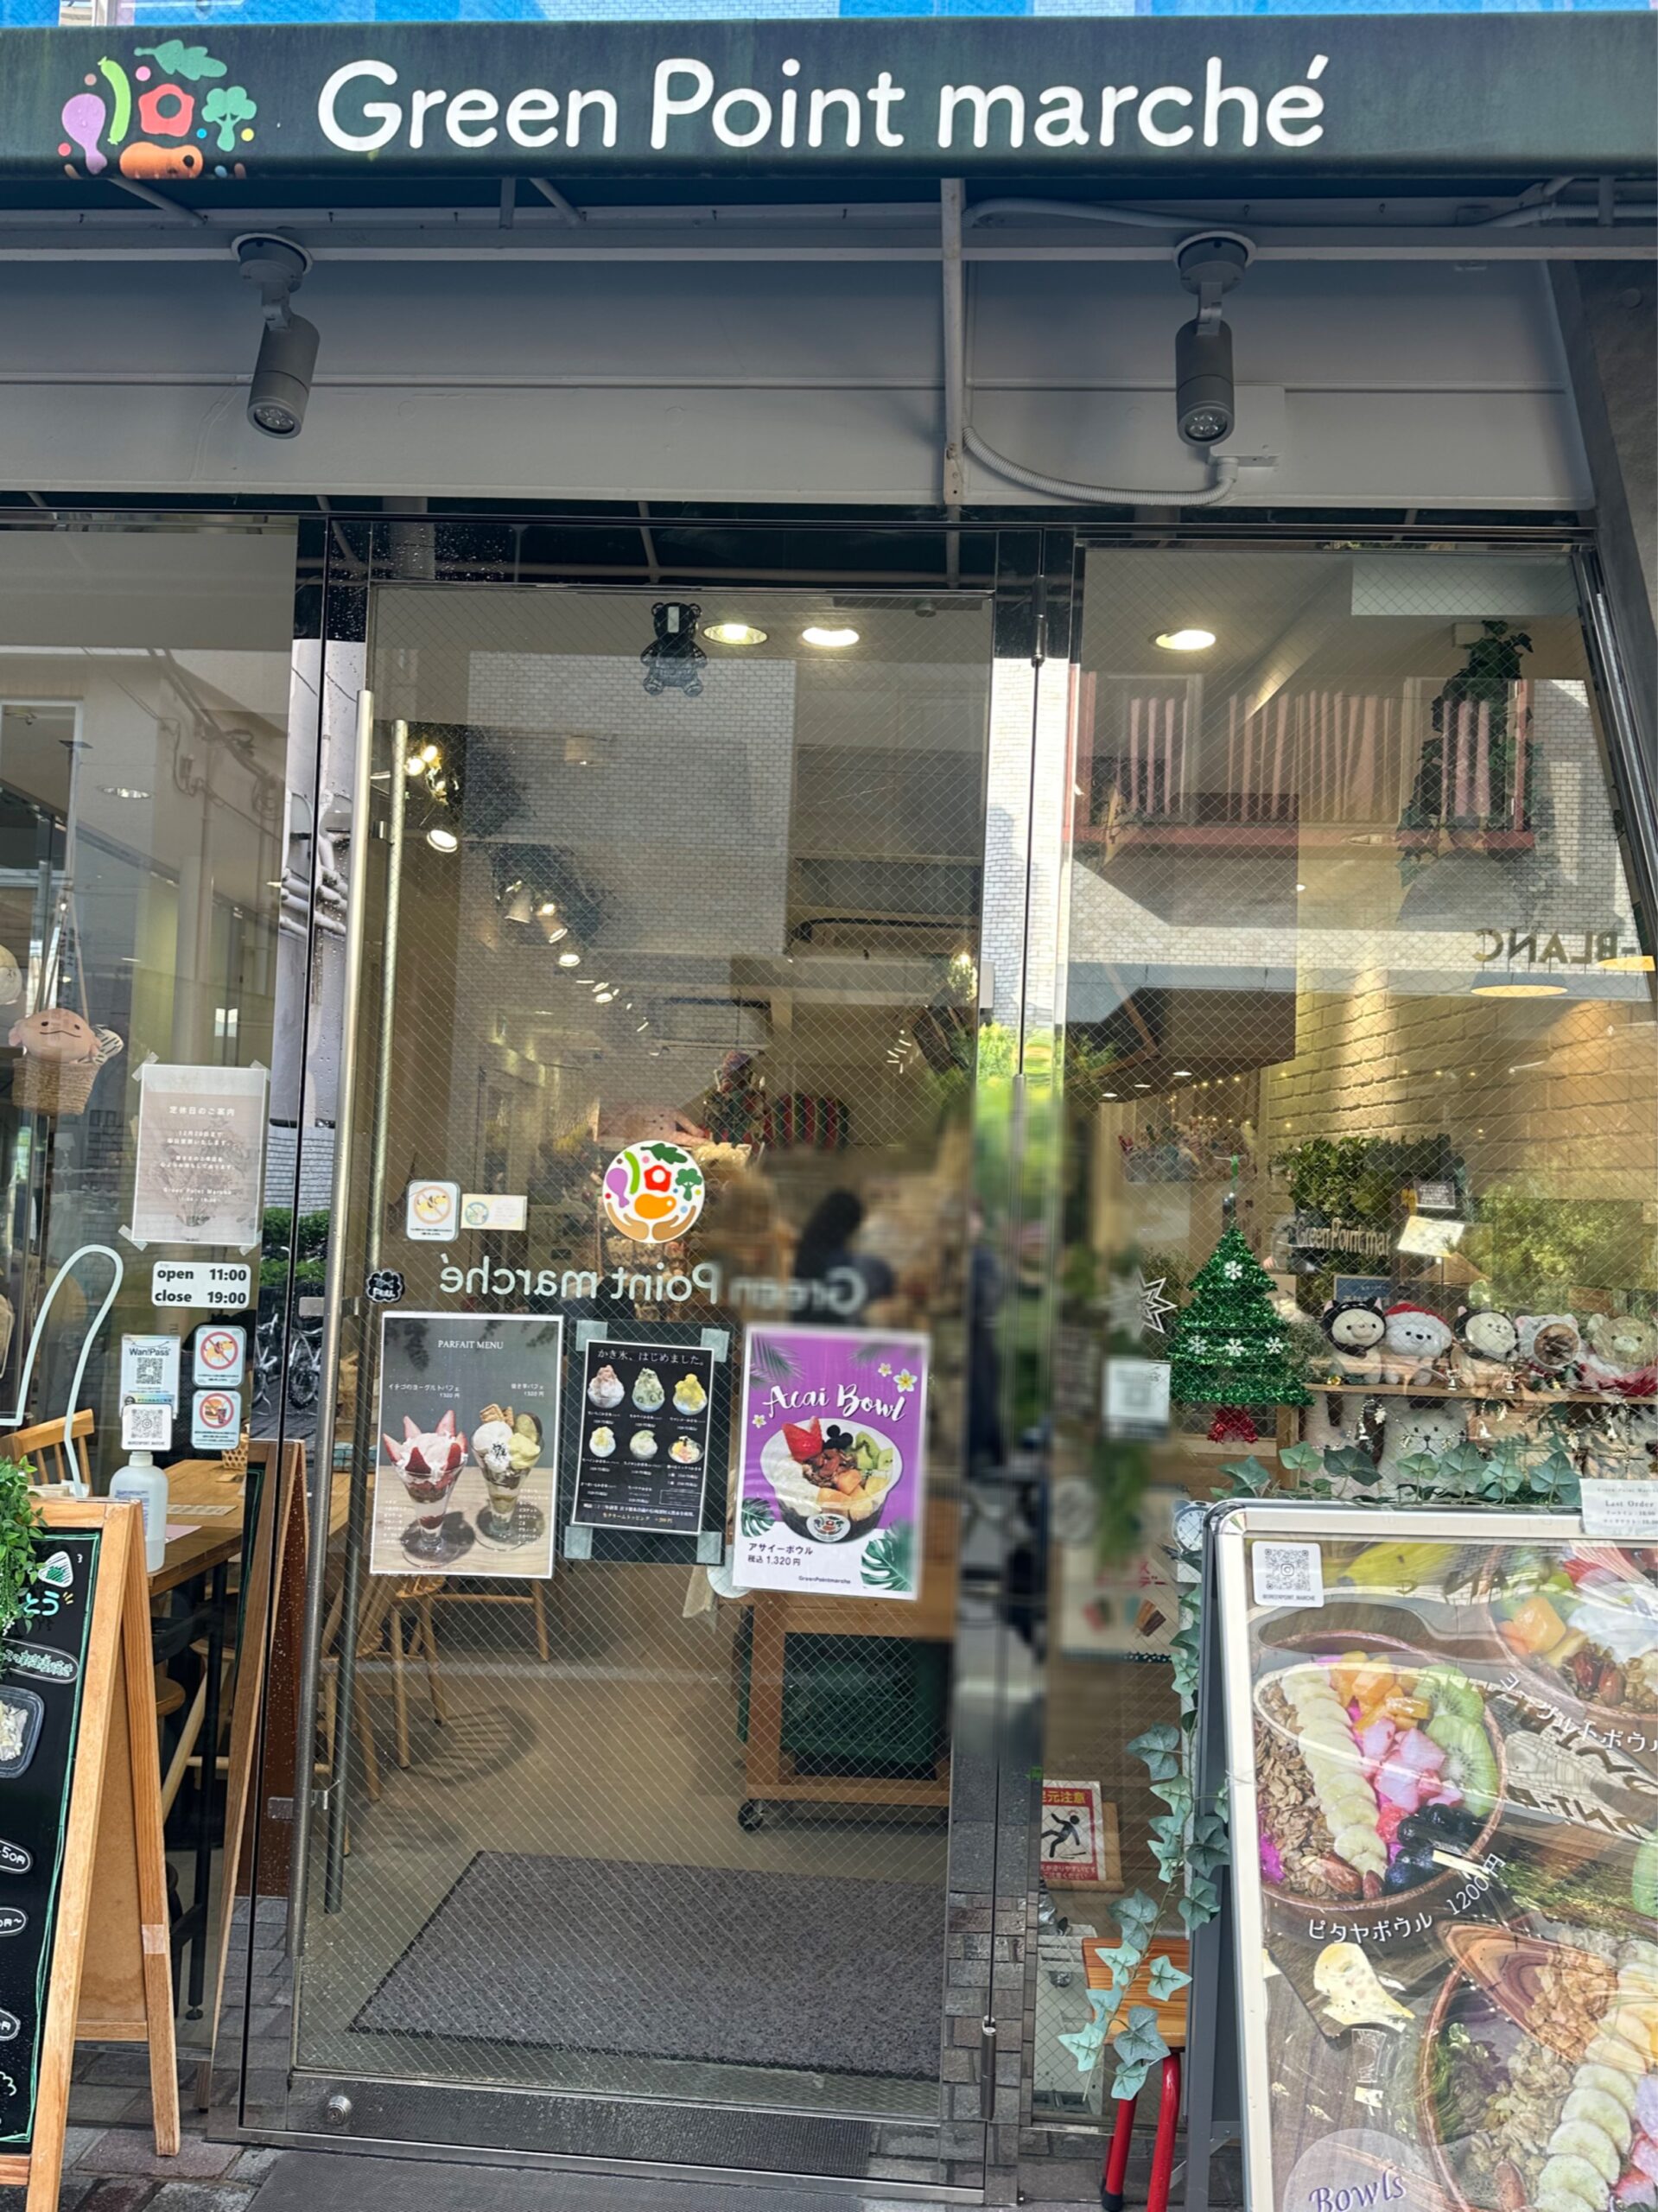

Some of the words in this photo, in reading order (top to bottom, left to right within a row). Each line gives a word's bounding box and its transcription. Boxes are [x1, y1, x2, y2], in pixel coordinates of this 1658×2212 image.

[319, 60, 617, 151] Green
[651, 59, 905, 149] Point
[938, 54, 1329, 149] marché
[169, 1106, 235, 1117] 定休日のご案内
[1331, 1217, 1363, 1252] Point
[157, 1270, 194, 1282] open
[210, 1268, 246, 1281] 11:00
[155, 1289, 192, 1302] close
[207, 1291, 246, 1304] 19:00
[438, 1339, 475, 1349] PARFAIT
[476, 1340, 504, 1350] MENU
[597, 1349, 704, 1366] かき氷、はじめました。
[388, 1382, 460, 1392] イチゴのヨーグルトパフェ
[763, 1384, 829, 1418] Acai
[836, 1383, 907, 1421] Bowl
[748, 1542, 813, 1556] アサイーボウル
[1309, 1911, 1433, 1944] ピタヤボウル
[1447, 1852, 1507, 1916] 1200円
[1308, 2169, 1407, 2212] Bowls
